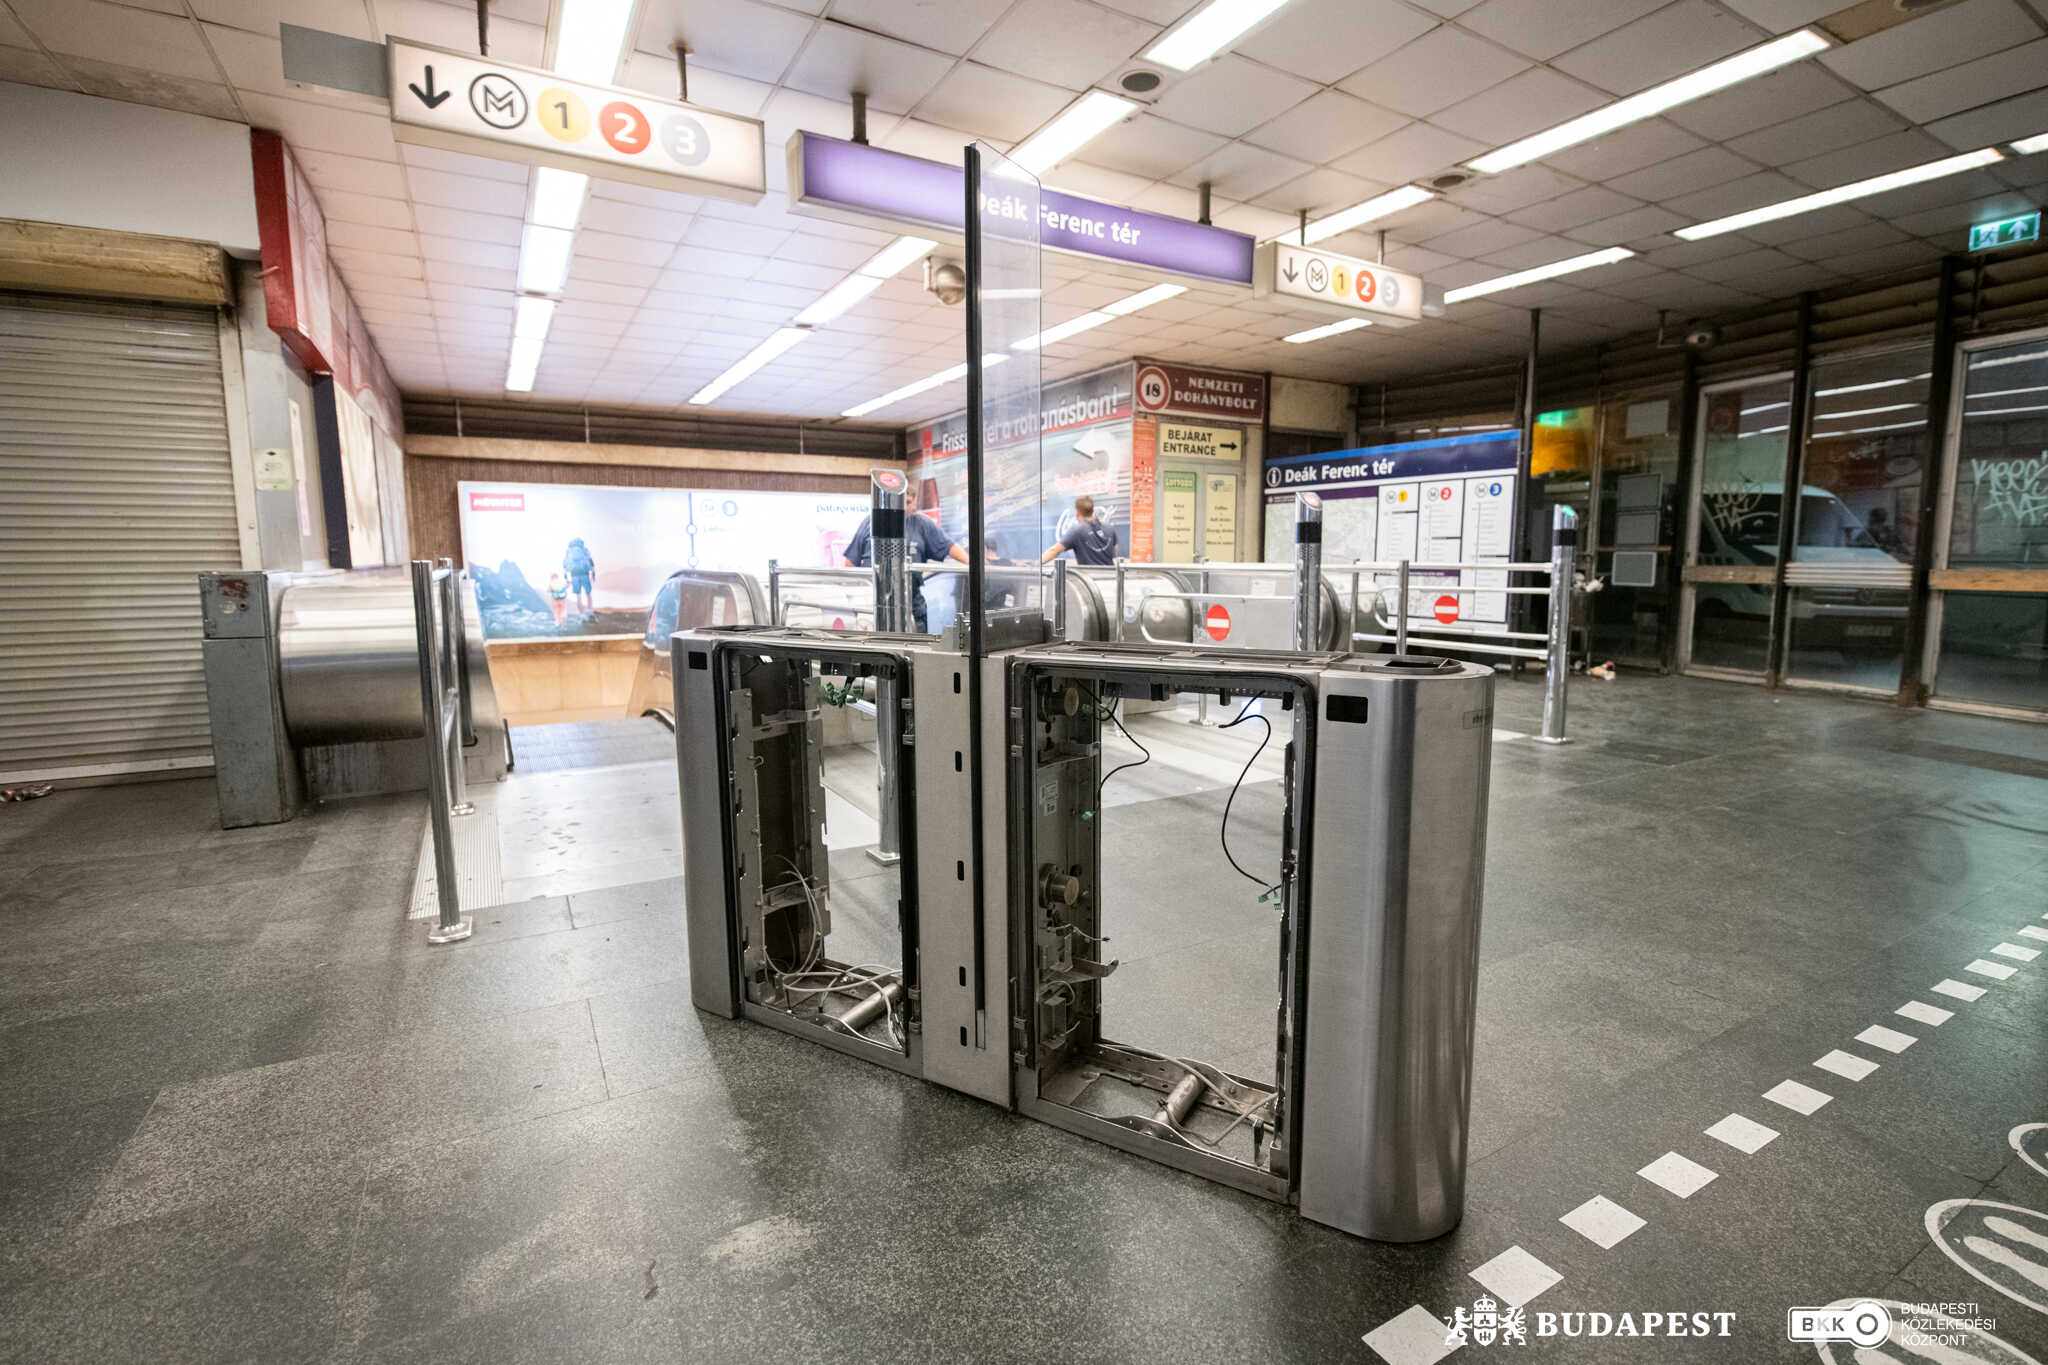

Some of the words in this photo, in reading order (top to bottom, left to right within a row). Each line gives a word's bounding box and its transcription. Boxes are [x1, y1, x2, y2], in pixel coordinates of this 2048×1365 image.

[553, 102, 569, 129] 1
[613, 112, 639, 144] 2
[675, 126, 694, 155] 3
[1036, 204, 1105, 238] Ferenc
[1110, 222, 1141, 245] tér
[1338, 272, 1344, 290] 1
[1360, 276, 1371, 297] 2
[1385, 283, 1395, 303] 3
[1145, 383, 1161, 397] 18
[1188, 376, 1244, 393] NEMZETI
[1174, 390, 1257, 410] DOHÁNYBOLT
[1168, 429, 1213, 442] BEJÁRAT
[1163, 442, 1216, 456] ENTRANCE
[1285, 466, 1317, 483] Deák
[1321, 463, 1368, 480] Ferenc
[1372, 458, 1395, 475] tér
